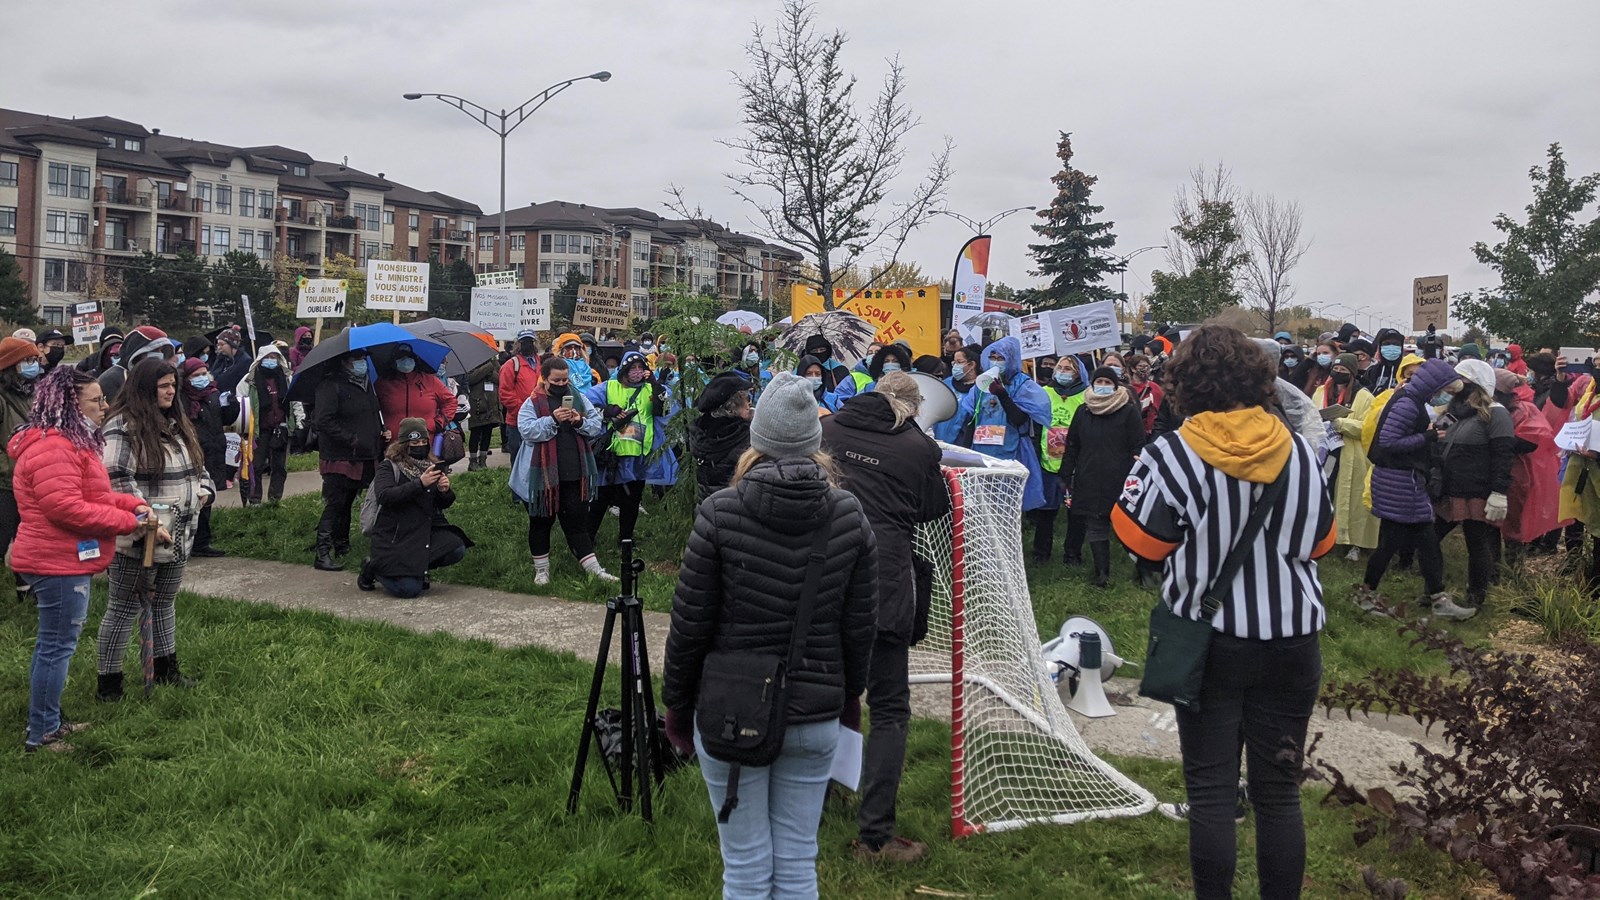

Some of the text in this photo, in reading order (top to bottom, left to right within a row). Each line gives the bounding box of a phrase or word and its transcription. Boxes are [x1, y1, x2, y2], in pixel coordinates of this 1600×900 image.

[377, 263, 417, 273] MONSIEUR
[374, 273, 424, 283] LE MINISTRE
[479, 279, 487, 287] ON
[495, 276, 514, 285] BESOIN
[304, 286, 340, 294] LES AINES
[375, 283, 422, 293] VOUS AUSSI
[370, 294, 424, 304] SEREZ UN AINE
[586, 289, 596, 297] 815
[597, 290, 608, 298] 400
[610, 292, 627, 301] AINES
[522, 298, 538, 306] ANS
[592, 298, 614, 307] QUEBEC
[307, 305, 332, 313] OUBLIES
[527, 308, 545, 316] VEUT
[576, 305, 629, 318] DES SUBVENTIONS
[520, 318, 540, 326] VIVRE
[579, 314, 625, 326] INSUFFISANTES
[1090, 322, 1111, 331] FEMMES
[845, 451, 880, 465] GITZO
